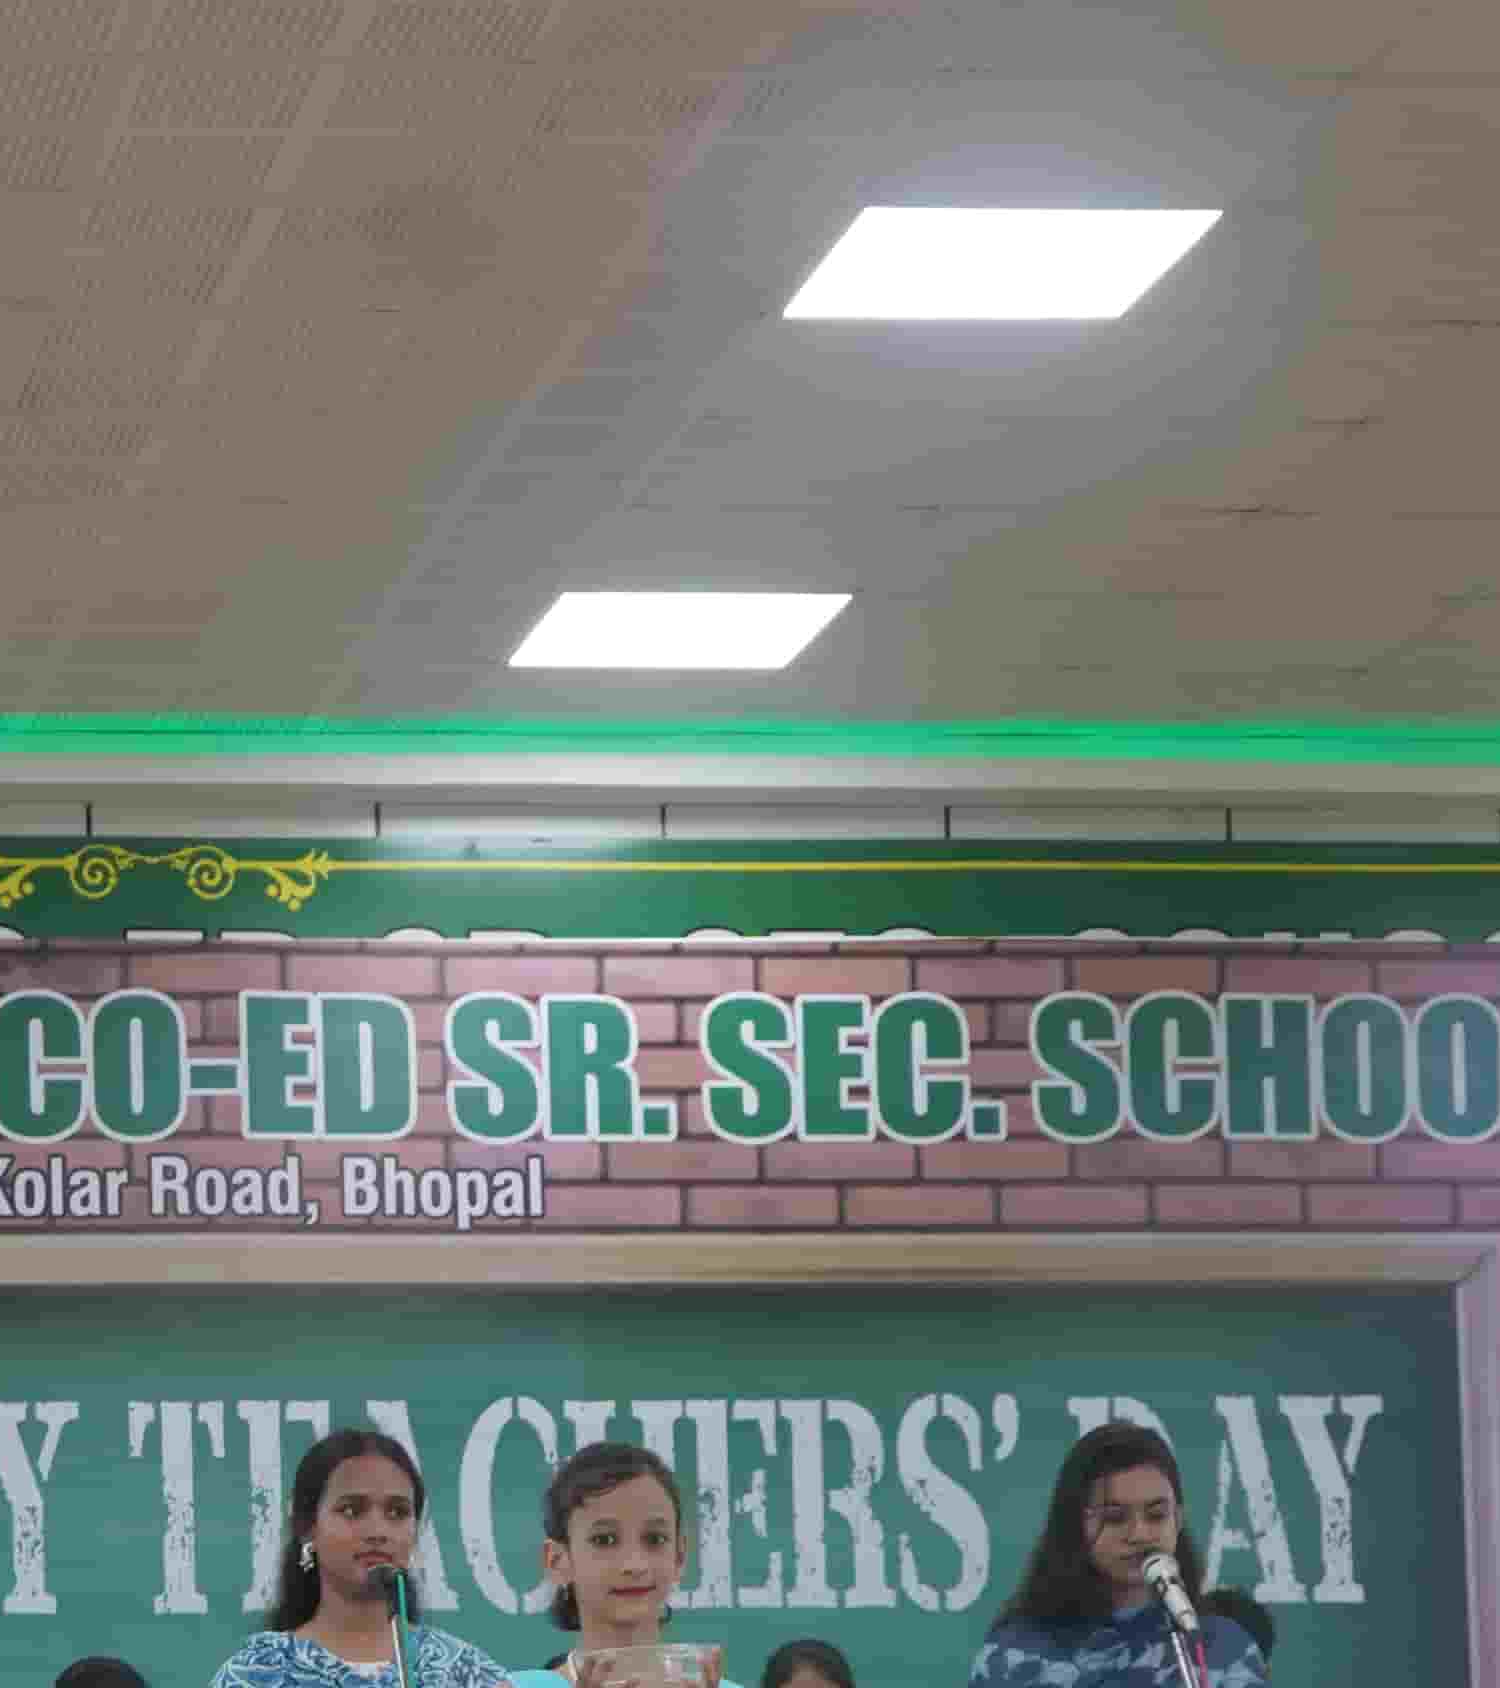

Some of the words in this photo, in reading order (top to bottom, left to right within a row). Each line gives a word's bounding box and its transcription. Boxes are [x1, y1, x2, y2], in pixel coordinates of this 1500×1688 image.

[443, 990, 679, 1145] SR.
[700, 991, 1006, 1144] SEC.
[150, 1154, 321, 1225] Road,
[341, 1154, 545, 1231] Bhopal
[1067, 1395, 1384, 1605] AY
